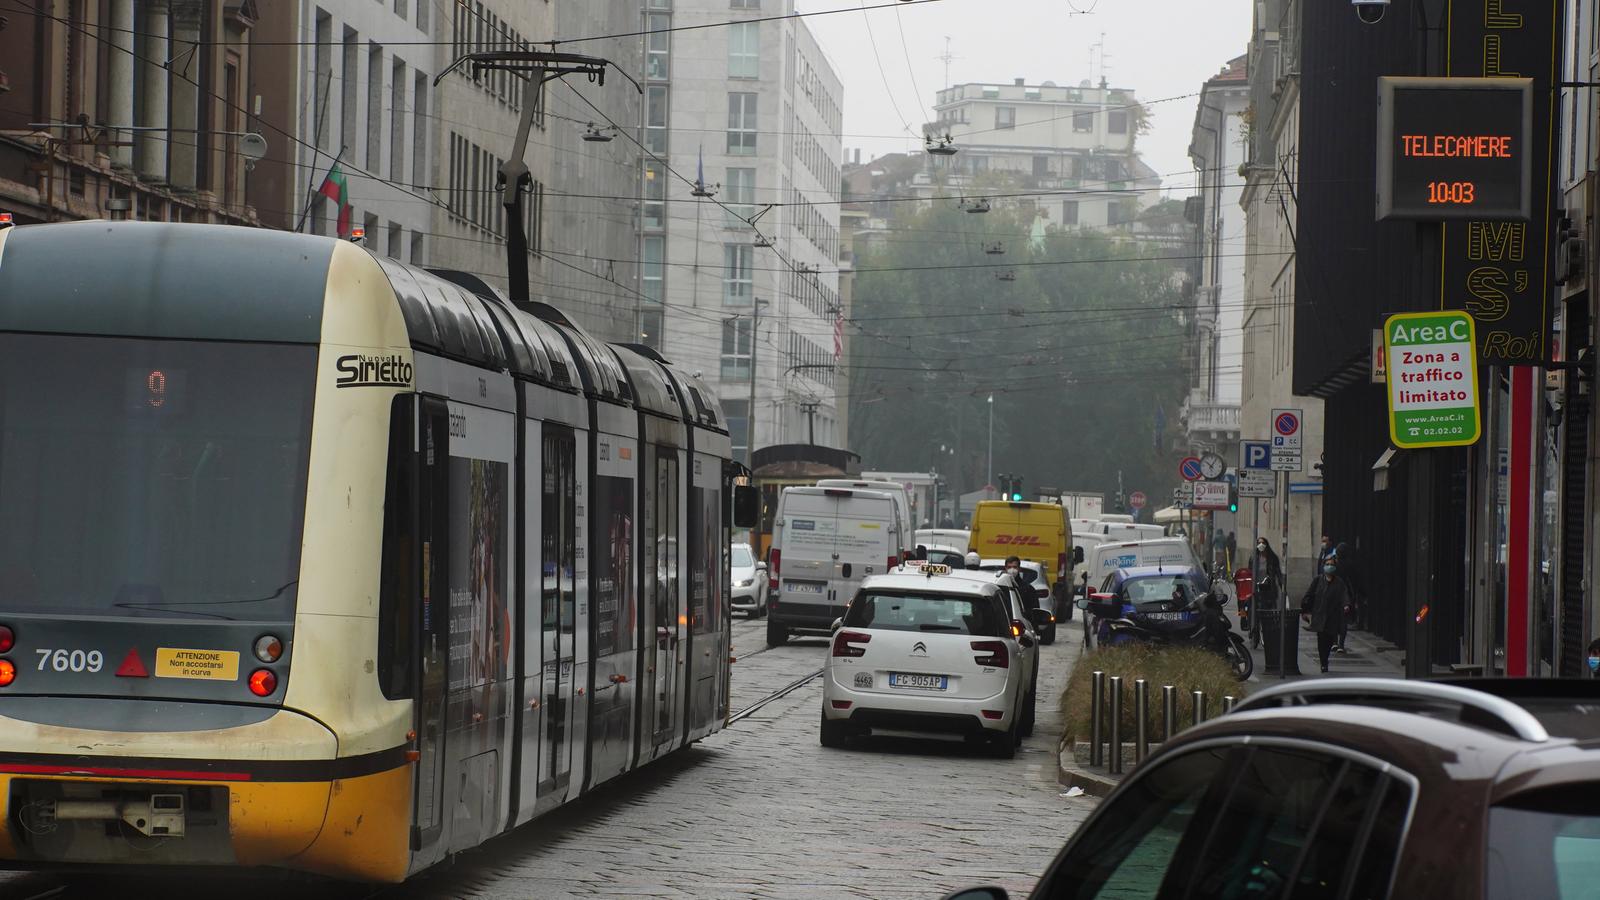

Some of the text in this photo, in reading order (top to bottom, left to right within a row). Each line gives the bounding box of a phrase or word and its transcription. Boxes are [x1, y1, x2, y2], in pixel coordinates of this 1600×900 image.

[1402, 135, 1511, 157] TELECAMERE
[1428, 182, 1474, 203] 10:03
[1483, 331, 1539, 359] Roi
[1403, 352, 1460, 364] Zona a
[336, 355, 412, 383] Sirietto
[1401, 368, 1463, 383] traffico
[1400, 390, 1467, 403] limitato
[1405, 414, 1464, 424] www.AreaC.it
[1423, 426, 1463, 435] 02.02.02
[1250, 446, 1265, 466] P
[995, 534, 1041, 547] DHL
[923, 565, 946, 573] TAXI
[36, 649, 103, 672] 7609
[176, 652, 220, 661] ATTENZIONE
[170, 660, 223, 669] Non accostarsi
[182, 668, 190, 676] in
[911, 676, 940, 686] 905AP
